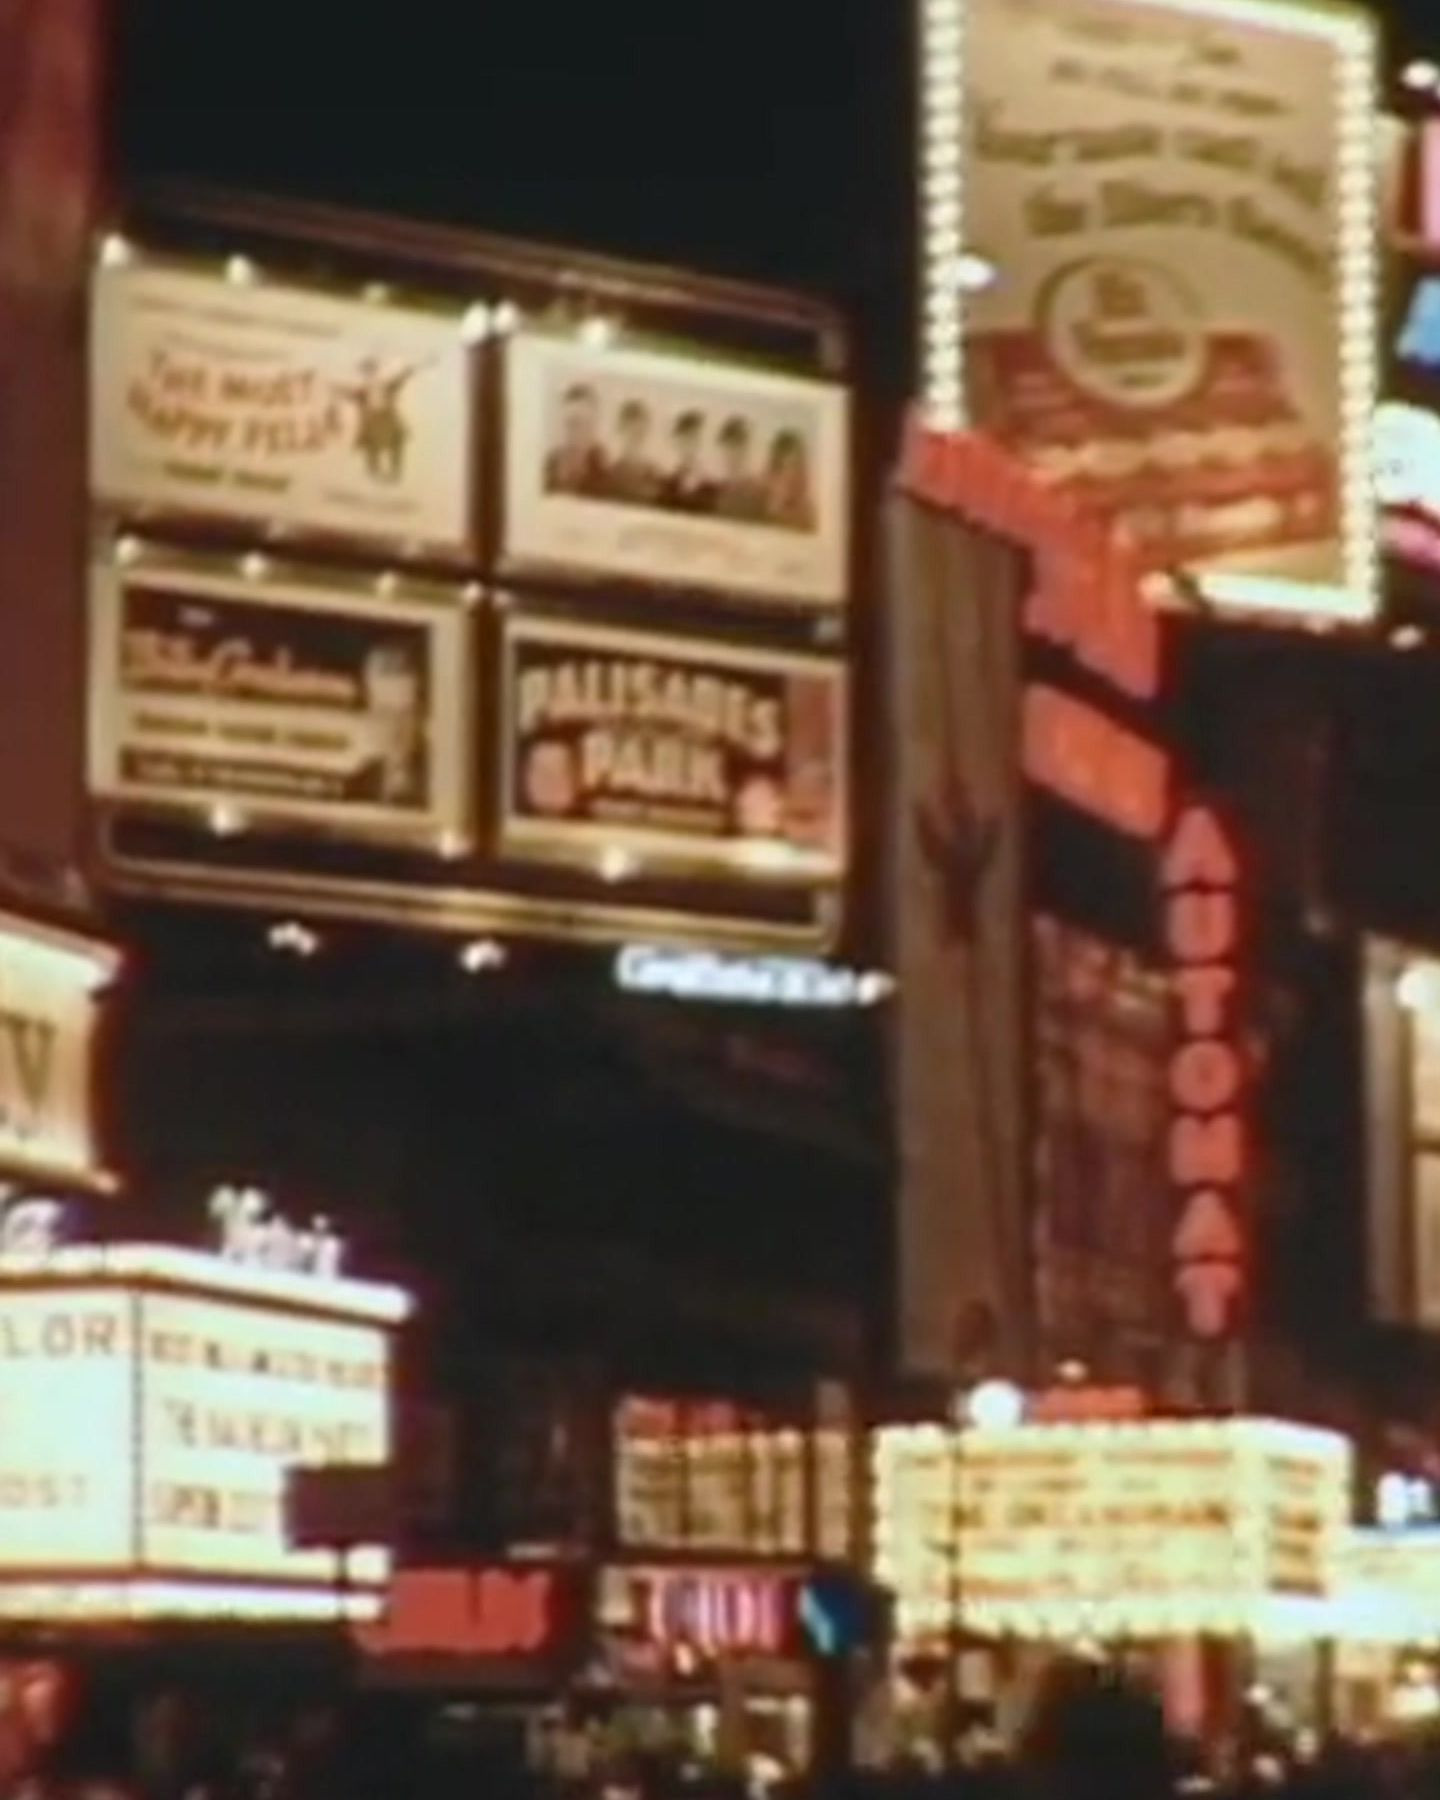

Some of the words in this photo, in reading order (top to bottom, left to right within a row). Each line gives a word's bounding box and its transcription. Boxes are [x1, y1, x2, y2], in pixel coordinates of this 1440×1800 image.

[126, 376, 233, 448] HAPPY
[149, 348, 207, 396] THE
[220, 367, 318, 407] MOST
[517, 659, 781, 760] PALISADES
[581, 727, 730, 802] PARK
[1162, 806, 1242, 1336] AUTOMAT
